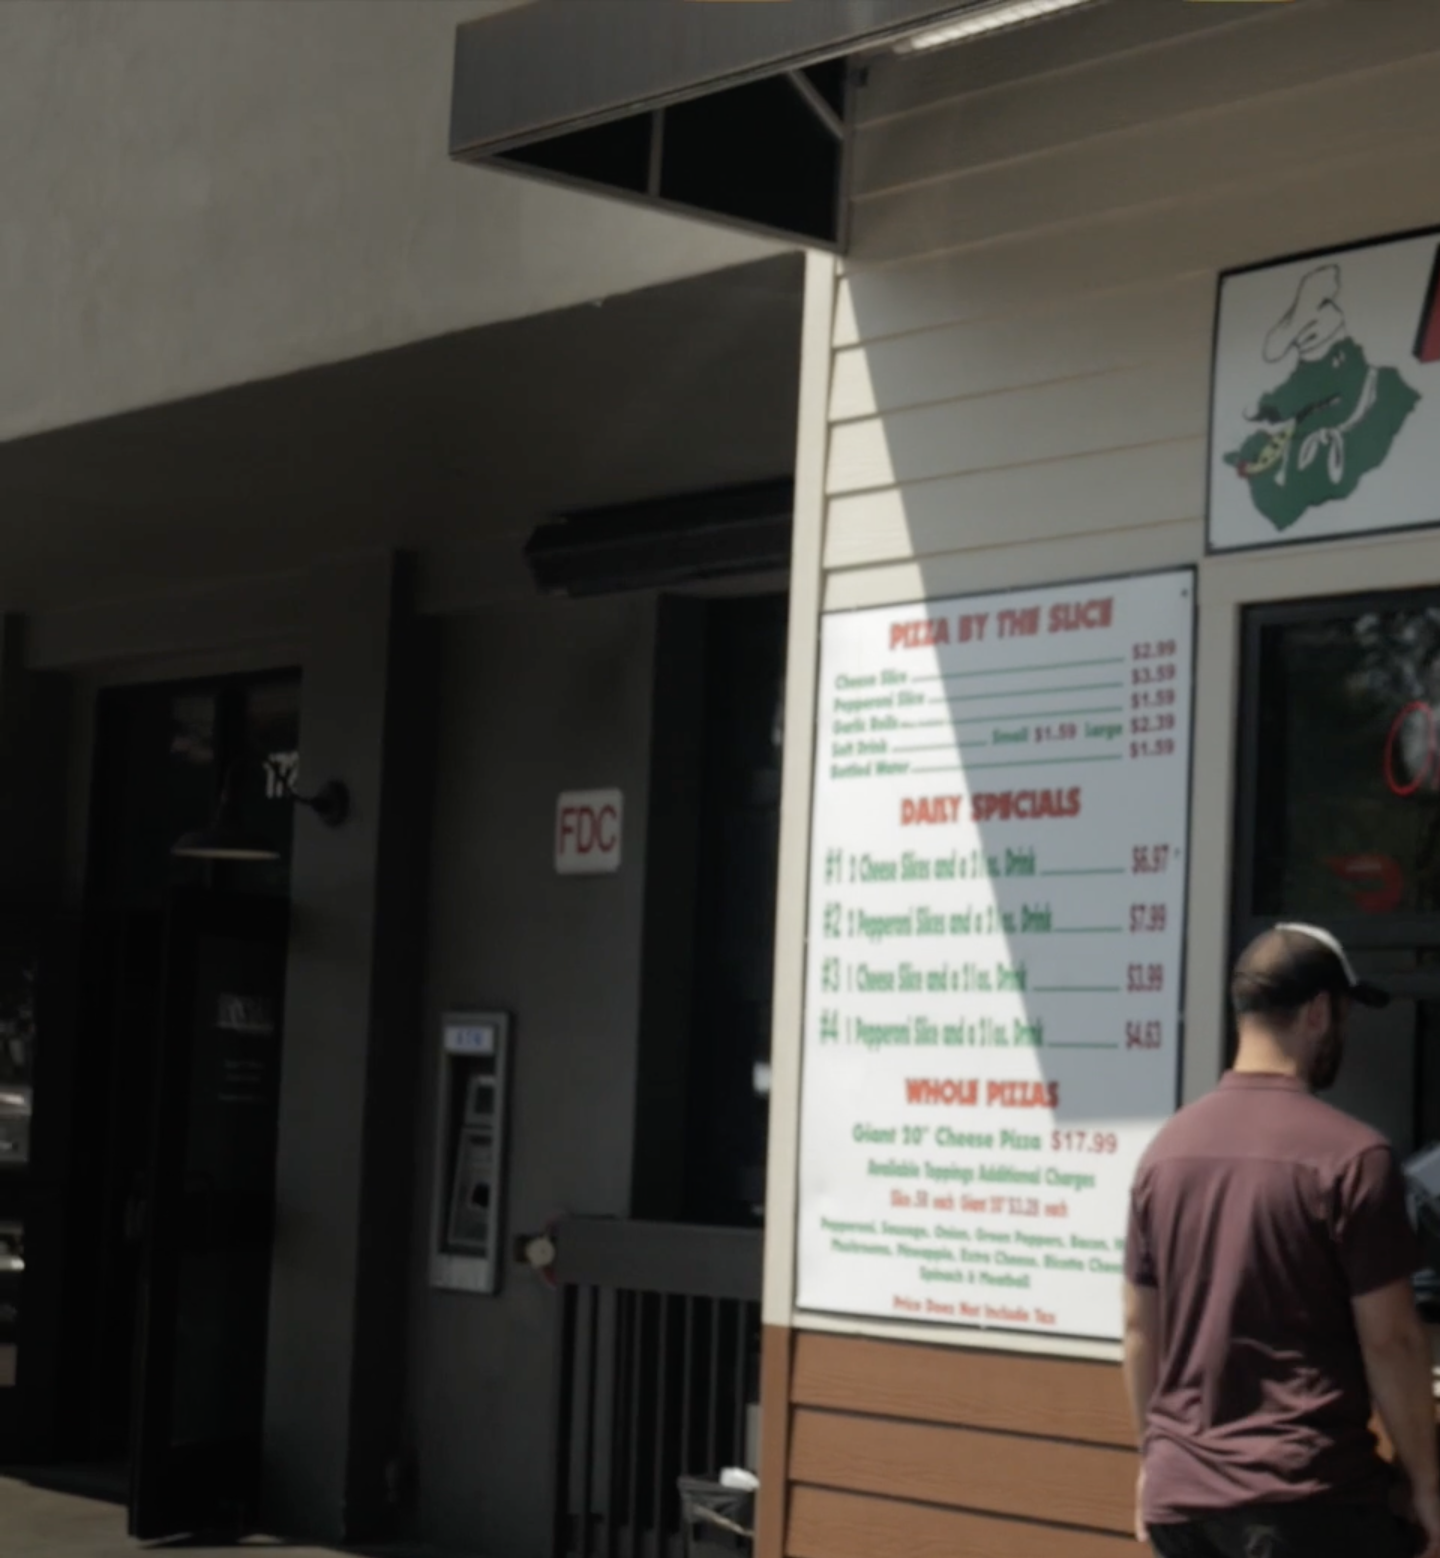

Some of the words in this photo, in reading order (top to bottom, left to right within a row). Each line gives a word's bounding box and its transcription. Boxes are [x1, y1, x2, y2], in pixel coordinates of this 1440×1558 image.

[889, 617, 950, 650] PIZZA
[958, 613, 988, 643] BY
[997, 607, 1039, 639] THE
[1048, 599, 1113, 633] SLICE
[834, 692, 893, 713] Pepperoni
[898, 691, 924, 706] Slice
[1132, 665, 1175, 685] $3.59
[836, 674, 876, 690] Cheese
[881, 669, 907, 685] Slice
[833, 719, 865, 735] Garlic
[1131, 689, 1174, 710] $1.59
[832, 741, 853, 757] Soft
[858, 740, 887, 755] Drink
[992, 729, 1029, 745] Small
[1034, 724, 1077, 743] $1.59
[1130, 714, 1174, 735] $2.39
[831, 763, 870, 780] Bottled
[876, 760, 910, 774] Water
[1129, 739, 1174, 759] $1.59
[900, 795, 962, 826] DAILY
[970, 787, 1082, 821] SPECIALS
[557, 805, 618, 855] FDC
[826, 848, 842, 884] #1
[860, 854, 897, 881] Cheese
[901, 852, 931, 881] Slices
[934, 848, 956, 879] and
[959, 858, 966, 879] a
[1005, 846, 1036, 877] Drink
[823, 903, 841, 938] #2
[858, 907, 912, 944] Pepperoni
[916, 906, 946, 935] Slices
[949, 904, 971, 934] and
[975, 913, 982, 934] a
[1021, 902, 1052, 933] Drink
[1130, 904, 1166, 933] $7.99
[822, 957, 840, 993] #3
[857, 963, 894, 992] Cheese
[898, 962, 923, 992] Slice
[927, 961, 947, 991] and
[952, 970, 959, 991] a
[997, 960, 1027, 992] Drink
[820, 1009, 838, 1044] #4
[856, 1015, 911, 1052] Pepperoni
[914, 1015, 939, 1045] Slice
[943, 1015, 964, 1045] and
[968, 1025, 974, 1045] a
[1014, 1015, 1043, 1046] Drink
[905, 1077, 979, 1106] WHOLE
[986, 1080, 1059, 1109] PIZZAS
[853, 1124, 897, 1145] Giant
[935, 1127, 993, 1149] Cheese
[1000, 1129, 1041, 1151] Pizza
[1051, 1130, 1118, 1154] $17.99
[867, 1158, 920, 1178] Available
[925, 1162, 974, 1185] Toppings
[978, 1164, 1041, 1185] Additional
[1045, 1167, 1096, 1191] Charges
[890, 1189, 911, 1208] Slice
[933, 1193, 954, 1210] each
[960, 1194, 987, 1213] Giant
[1044, 1200, 1068, 1218] each
[975, 1227, 1011, 1244] Green
[919, 1266, 963, 1285] Spinach
[979, 1271, 1030, 1289] Meatball
[960, 1247, 990, 1263] Extra
[1043, 1253, 1084, 1271] Ricotta
[892, 1294, 921, 1311] Price
[925, 1297, 955, 1314] Does
[959, 1299, 980, 1317] Not
[985, 1301, 1029, 1321] Include
[1034, 1307, 1055, 1324] Tax
